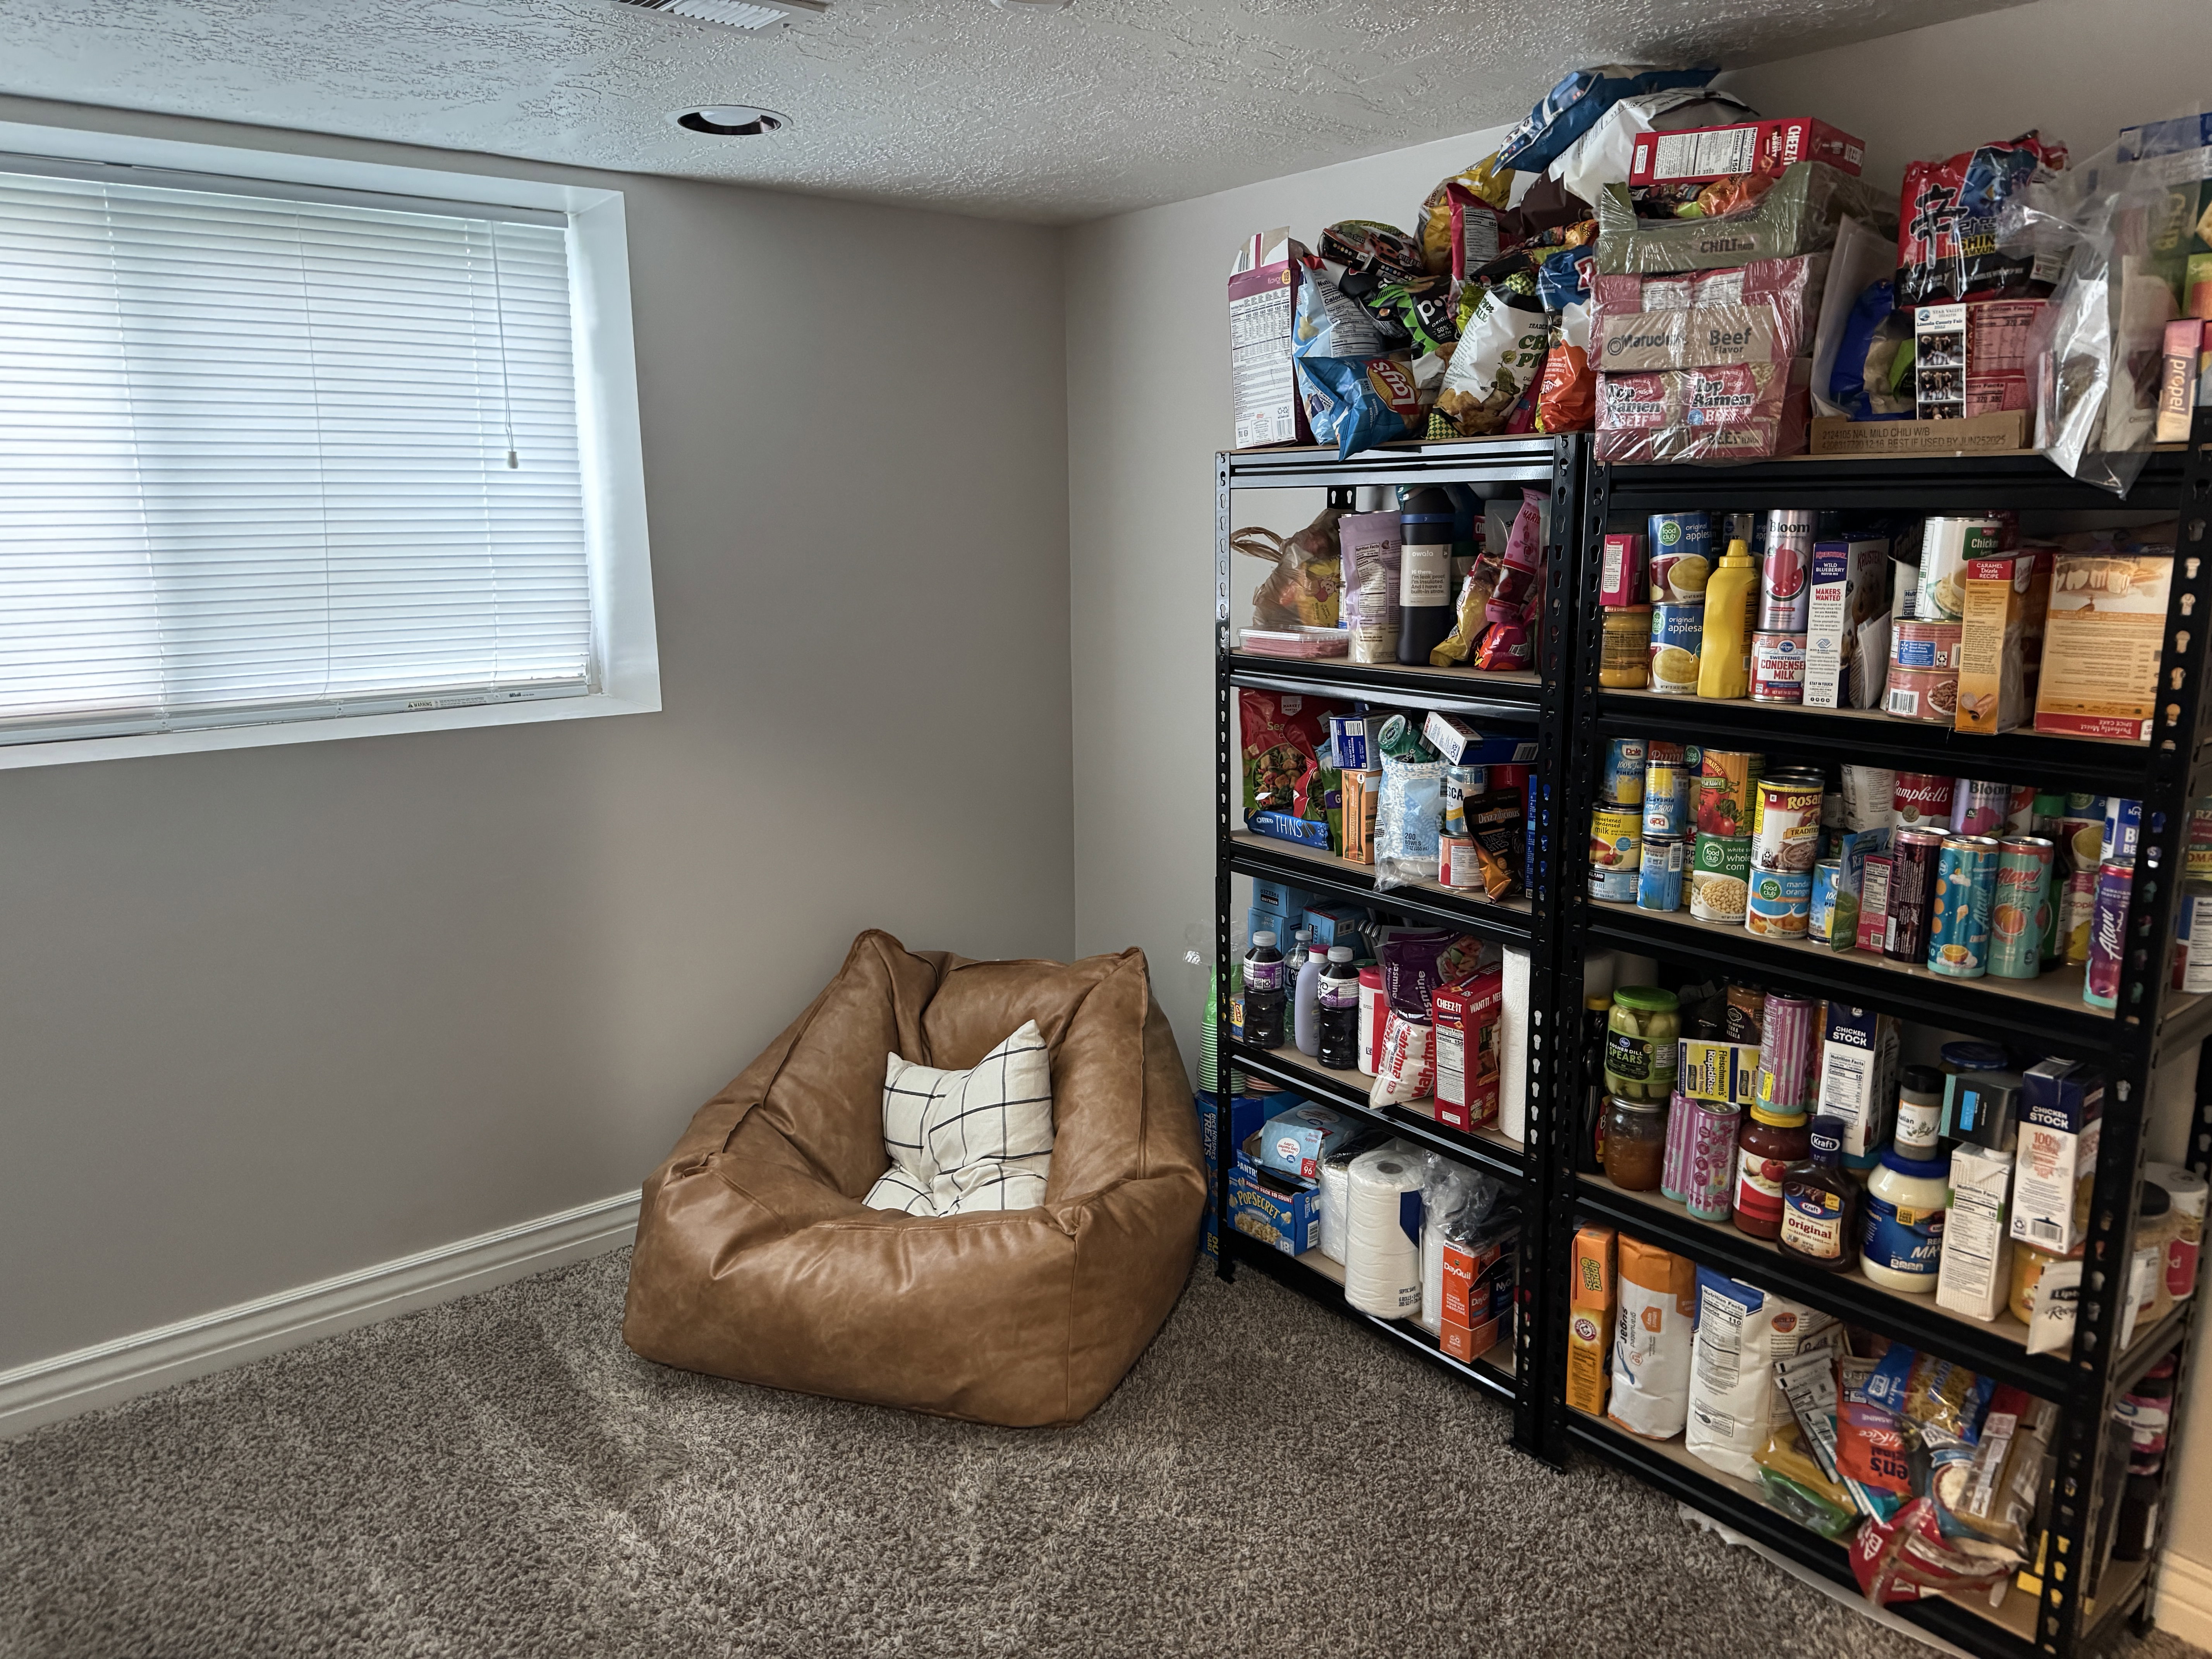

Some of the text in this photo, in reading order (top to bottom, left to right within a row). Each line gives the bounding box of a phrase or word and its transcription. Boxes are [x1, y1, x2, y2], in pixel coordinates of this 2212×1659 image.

[1733, 130, 1742, 155] Calories
[1700, 239, 1737, 253] CHILI
[1961, 234, 1996, 250] SHIN
[1284, 271, 1290, 280] 18
[1437, 325, 1449, 334] 50%
[1709, 328, 1752, 347] Beef
[1713, 345, 1744, 355] Flavor
[1373, 361, 1415, 405] Lay's
[2167, 359, 2187, 412] propel
[1691, 393, 1754, 407] Ramen
[1621, 415, 1649, 426] BEEF
[1853, 430, 1868, 438] NAL
[1870, 428, 1888, 438] MILD
[1891, 428, 1912, 437] CHILI
[1914, 427, 1930, 435] W/B
[1888, 438, 1909, 448] BEST
[1921, 437, 1943, 447] USED
[1947, 437, 1958, 445] BY
[1770, 519, 1810, 534] Bloom
[1774, 670, 1795, 680] MILK
[1705, 757, 1723, 775] TOMATOES
[1658, 804, 1673, 812] 100%
[1479, 809, 1520, 824] Drizzilicious
[1276, 815, 1302, 838] THINS
[1260, 889, 1278, 898] FREEZER
[2099, 906, 2123, 960] Alani
[1417, 970, 1432, 1021] Jasmine
[1470, 997, 1489, 1013] WANT IT
[1836, 1026, 1866, 1037] CHICKEN
[1833, 1032, 1867, 1046] STOCK
[1609, 1047, 1642, 1064] SPEARS
[1831, 1053, 1851, 1061] Nutrition
[1706, 1050, 1716, 1095] RapidRise
[2033, 1106, 2068, 1118] CHICKEN
[2030, 1112, 2069, 1129] STOCK
[1204, 1113, 1212, 1157] TREATS
[1813, 1136, 1834, 1149] Kraft
[1304, 1166, 1313, 1175] 96
[1246, 1181, 1259, 1190] PANTRY
[1261, 1186, 1271, 1195] PACK
[1278, 1193, 1292, 1203] COUNT
[1957, 1184, 1998, 1199] Nutrition Facts
[1804, 1204, 1818, 1212] Kraft
[1955, 1203, 1975, 1212] Calories
[1788, 1218, 1832, 1239] Original
[1279, 1240, 1290, 1252] 18
[1445, 1242, 1462, 1252] POWERFUL
[1444, 1262, 1470, 1279] DayQuil
[1592, 1260, 1603, 1291] Daddy
[1447, 1293, 1460, 1302] POWER
[1704, 1290, 1726, 1304] Nutrition
[1729, 1317, 1741, 1325] 110
